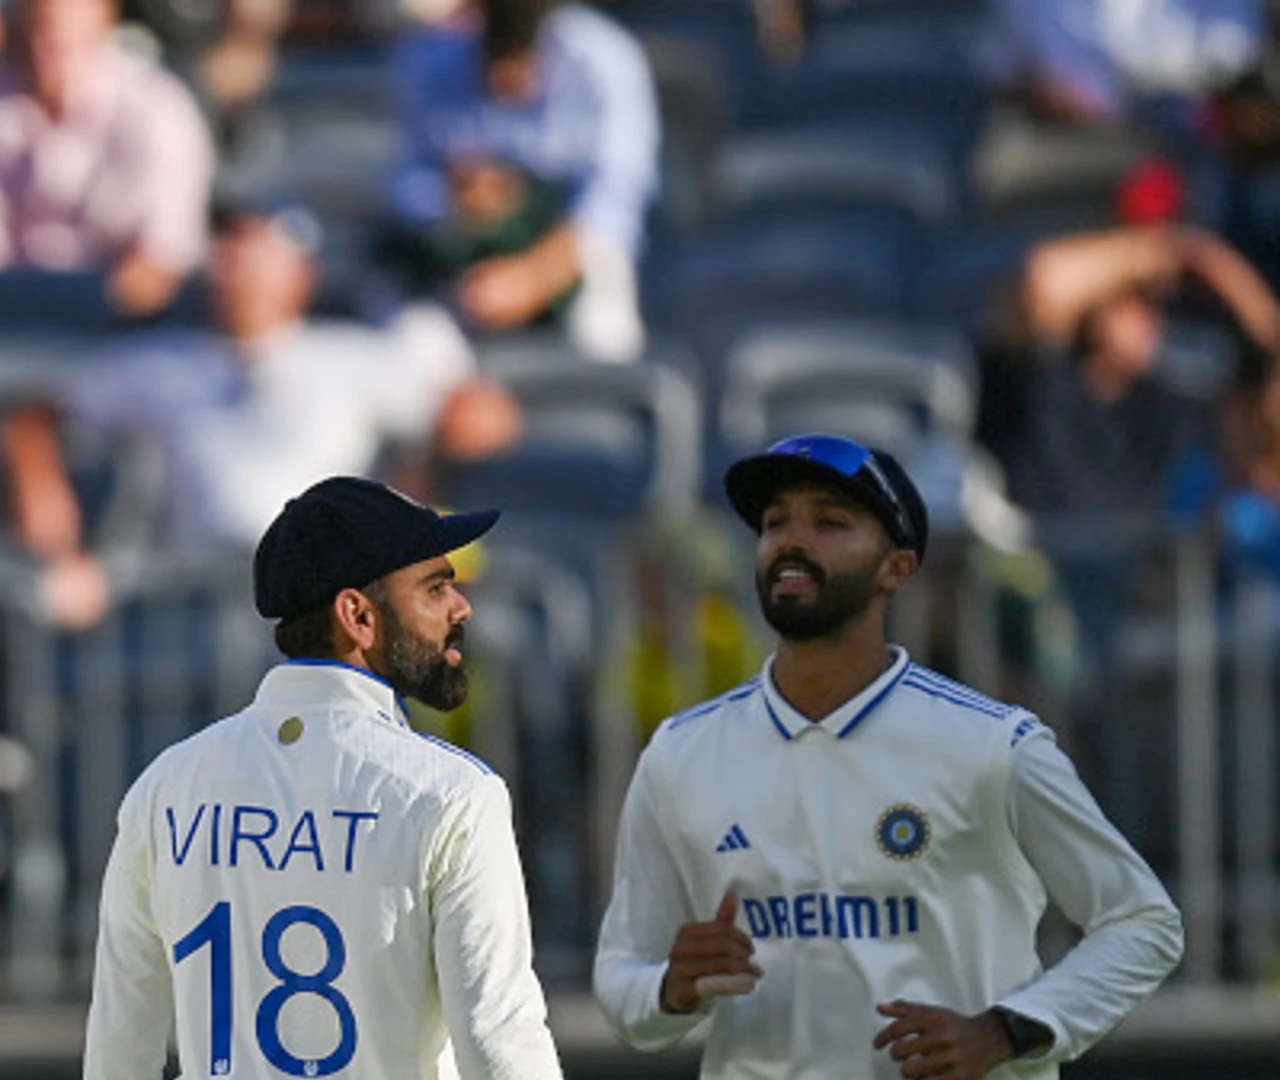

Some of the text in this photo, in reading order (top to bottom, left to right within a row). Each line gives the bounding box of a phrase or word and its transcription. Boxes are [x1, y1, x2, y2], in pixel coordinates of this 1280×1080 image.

[165, 803, 379, 873] VIRAT
[742, 892, 920, 939] DREAM11
[172, 901, 359, 1079] 18
